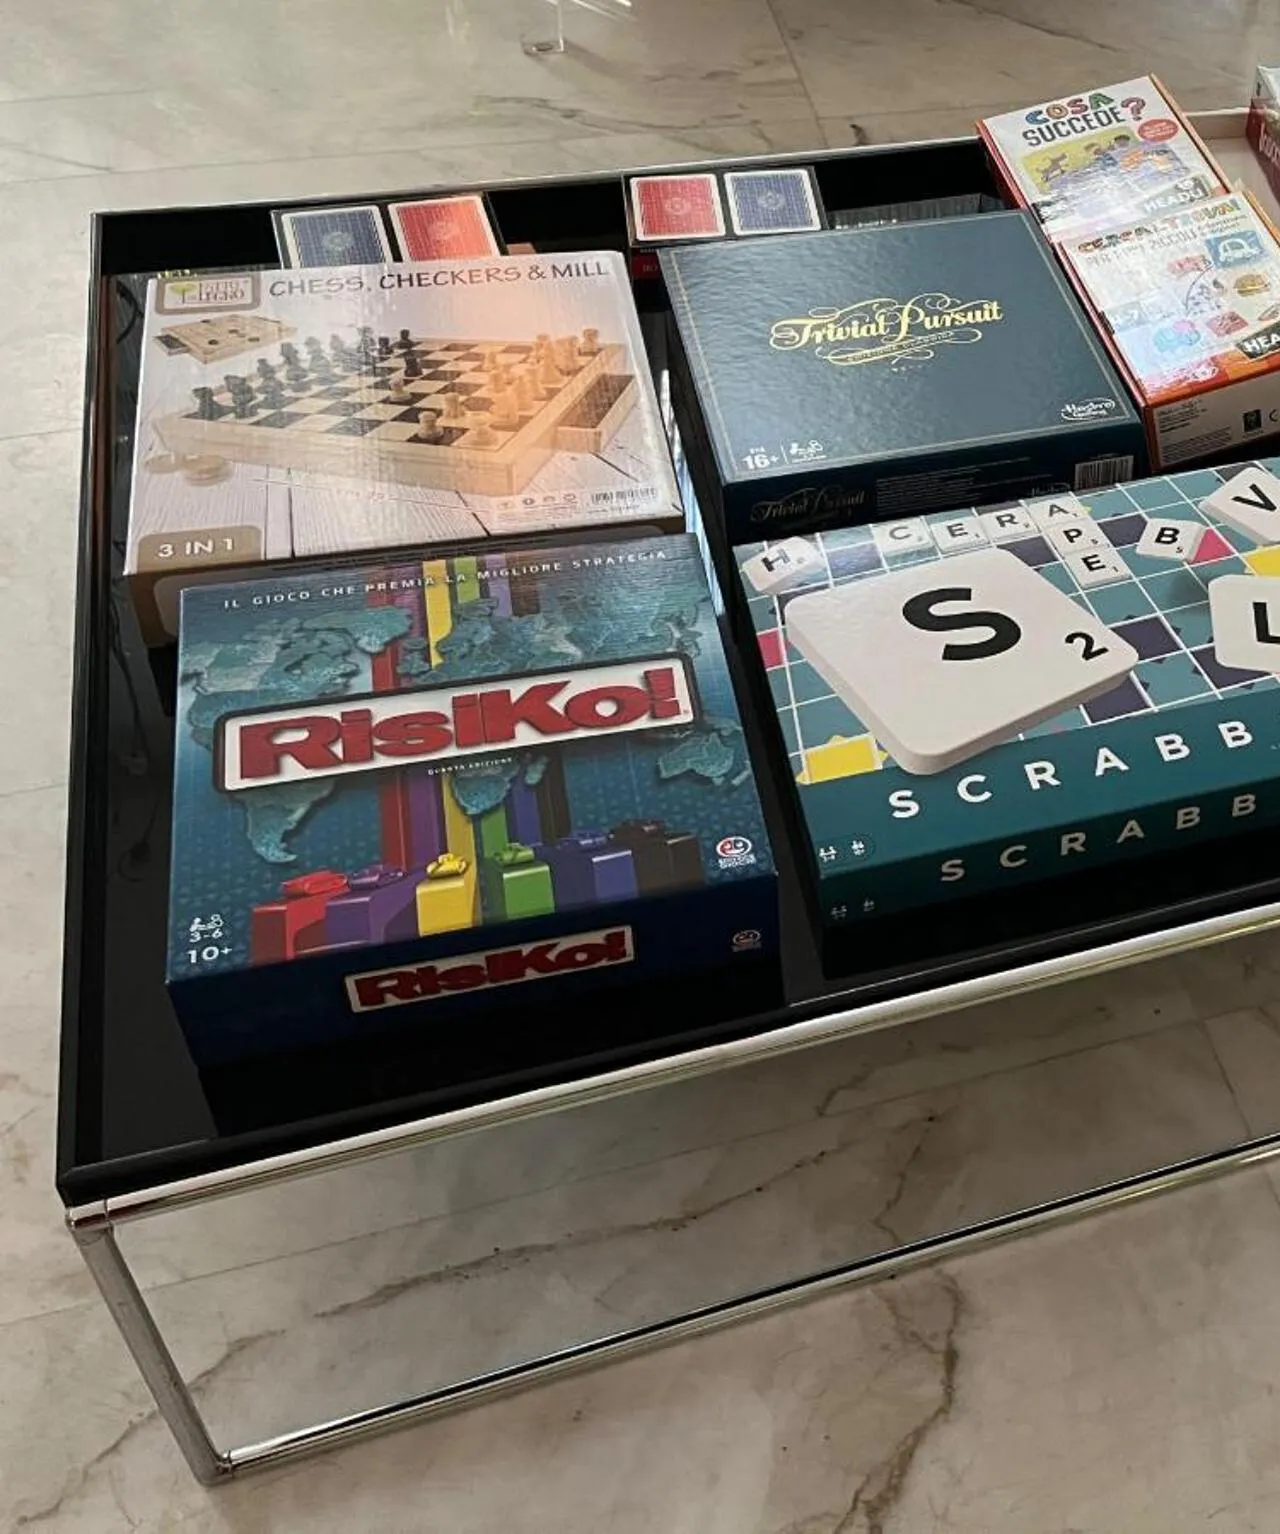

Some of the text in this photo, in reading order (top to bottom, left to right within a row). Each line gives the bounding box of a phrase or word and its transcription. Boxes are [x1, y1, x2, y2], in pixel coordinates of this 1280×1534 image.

[1025, 92, 1114, 125] COSA
[269, 261, 612, 297] CHESS, CHECKERS & MILL
[769, 297, 899, 350] Trivial
[876, 292, 1004, 344] Pursuit
[742, 453, 780, 470] 16+
[1231, 483, 1278, 512] V
[158, 538, 233, 558] 3 IN 1
[1154, 526, 1181, 545] B
[760, 548, 792, 572] H
[223, 550, 667, 609] IL GIOCO CHE PREMIA LA MIGLIORE STRATEGIA
[902, 587, 1109, 661] S 2
[188, 928, 224, 943] 3-6
[186, 946, 233, 964] 10+
